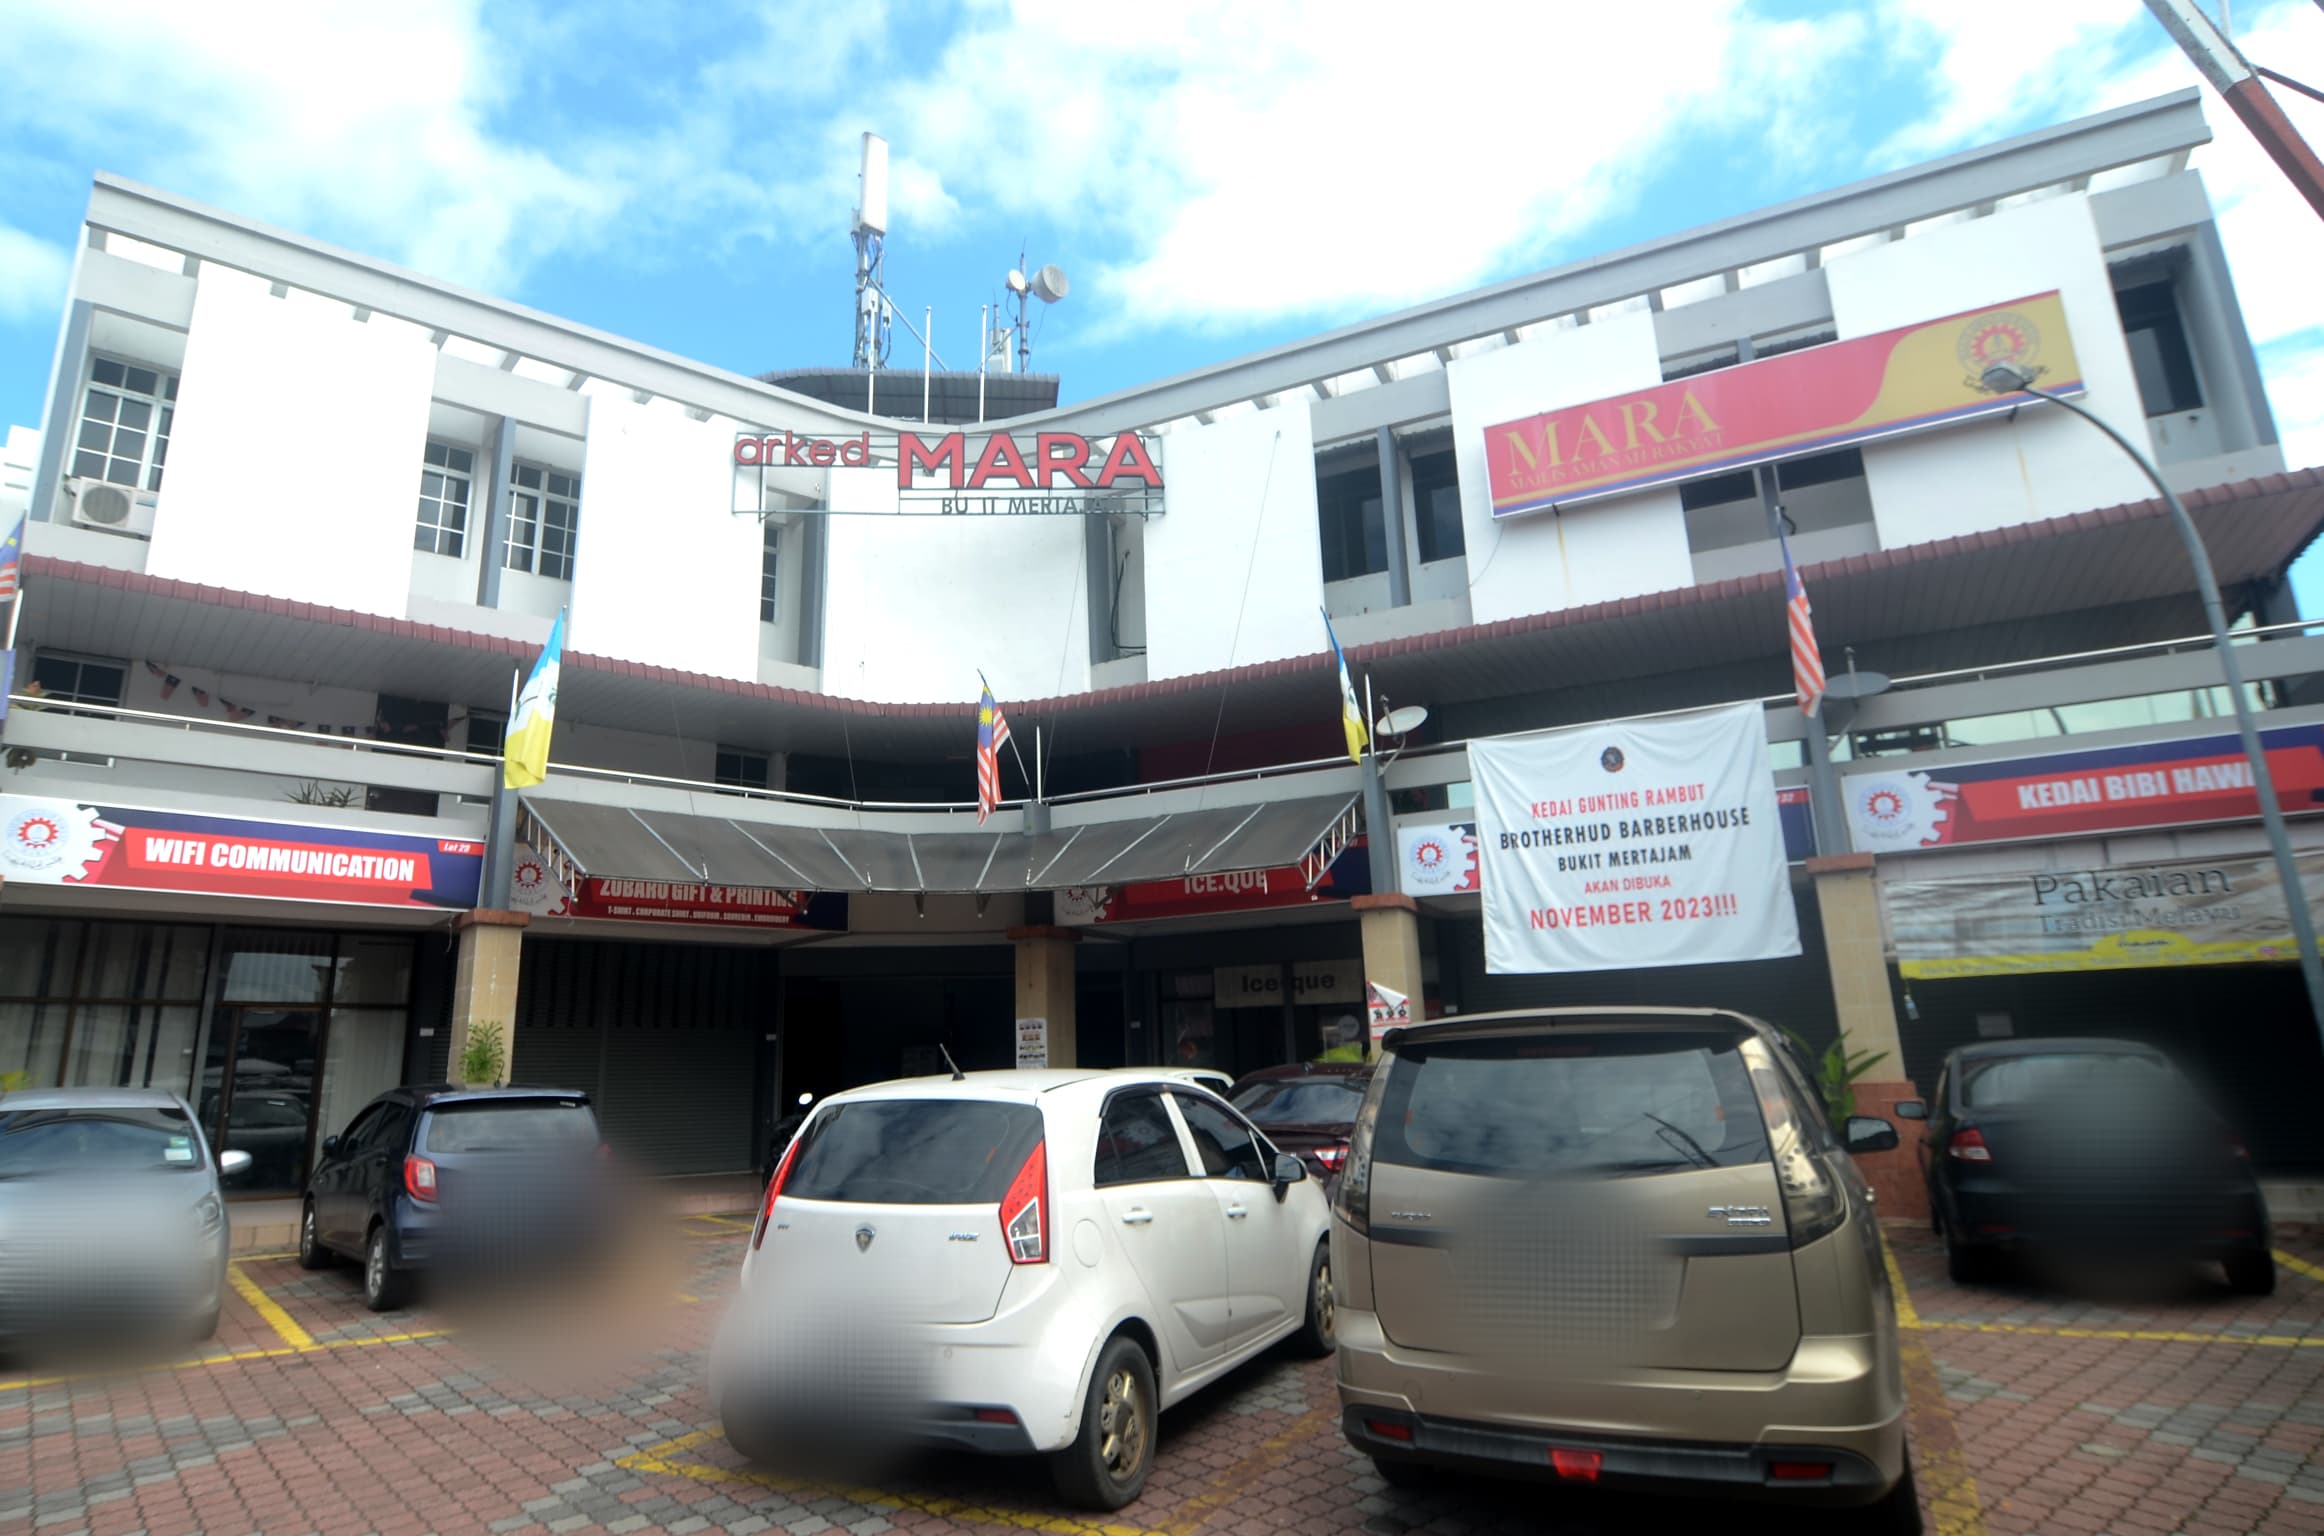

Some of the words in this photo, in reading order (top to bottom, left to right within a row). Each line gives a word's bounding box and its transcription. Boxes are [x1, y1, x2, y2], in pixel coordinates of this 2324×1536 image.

[1505, 391, 1721, 475] MARA
[733, 429, 871, 467] arked
[898, 431, 1166, 489] MARA
[1531, 797, 1573, 819] KEDAI
[1578, 789, 1639, 813] GUNTING
[1645, 783, 1706, 806] RAMBUT
[2016, 778, 2101, 810] KEDAI
[2104, 770, 2169, 801] BIBI
[1500, 822, 1612, 850] BROTHERHUD
[1619, 806, 1751, 840] BARBERHOUSE
[145, 836, 203, 866] WIFI
[209, 843, 415, 882] COMMUNICATION
[1557, 852, 1602, 872] BUKIT
[1608, 844, 1693, 867] MERTAJAM
[710, 886, 723, 903] &
[1584, 879, 1620, 894] AKAN
[1623, 874, 1672, 891] DIBUKA
[2029, 864, 2232, 906] Pakaian
[1530, 902, 1652, 930] NOVEMBER
[1660, 893, 1738, 921] 2023!!!
[1242, 975, 1279, 993] Ice
